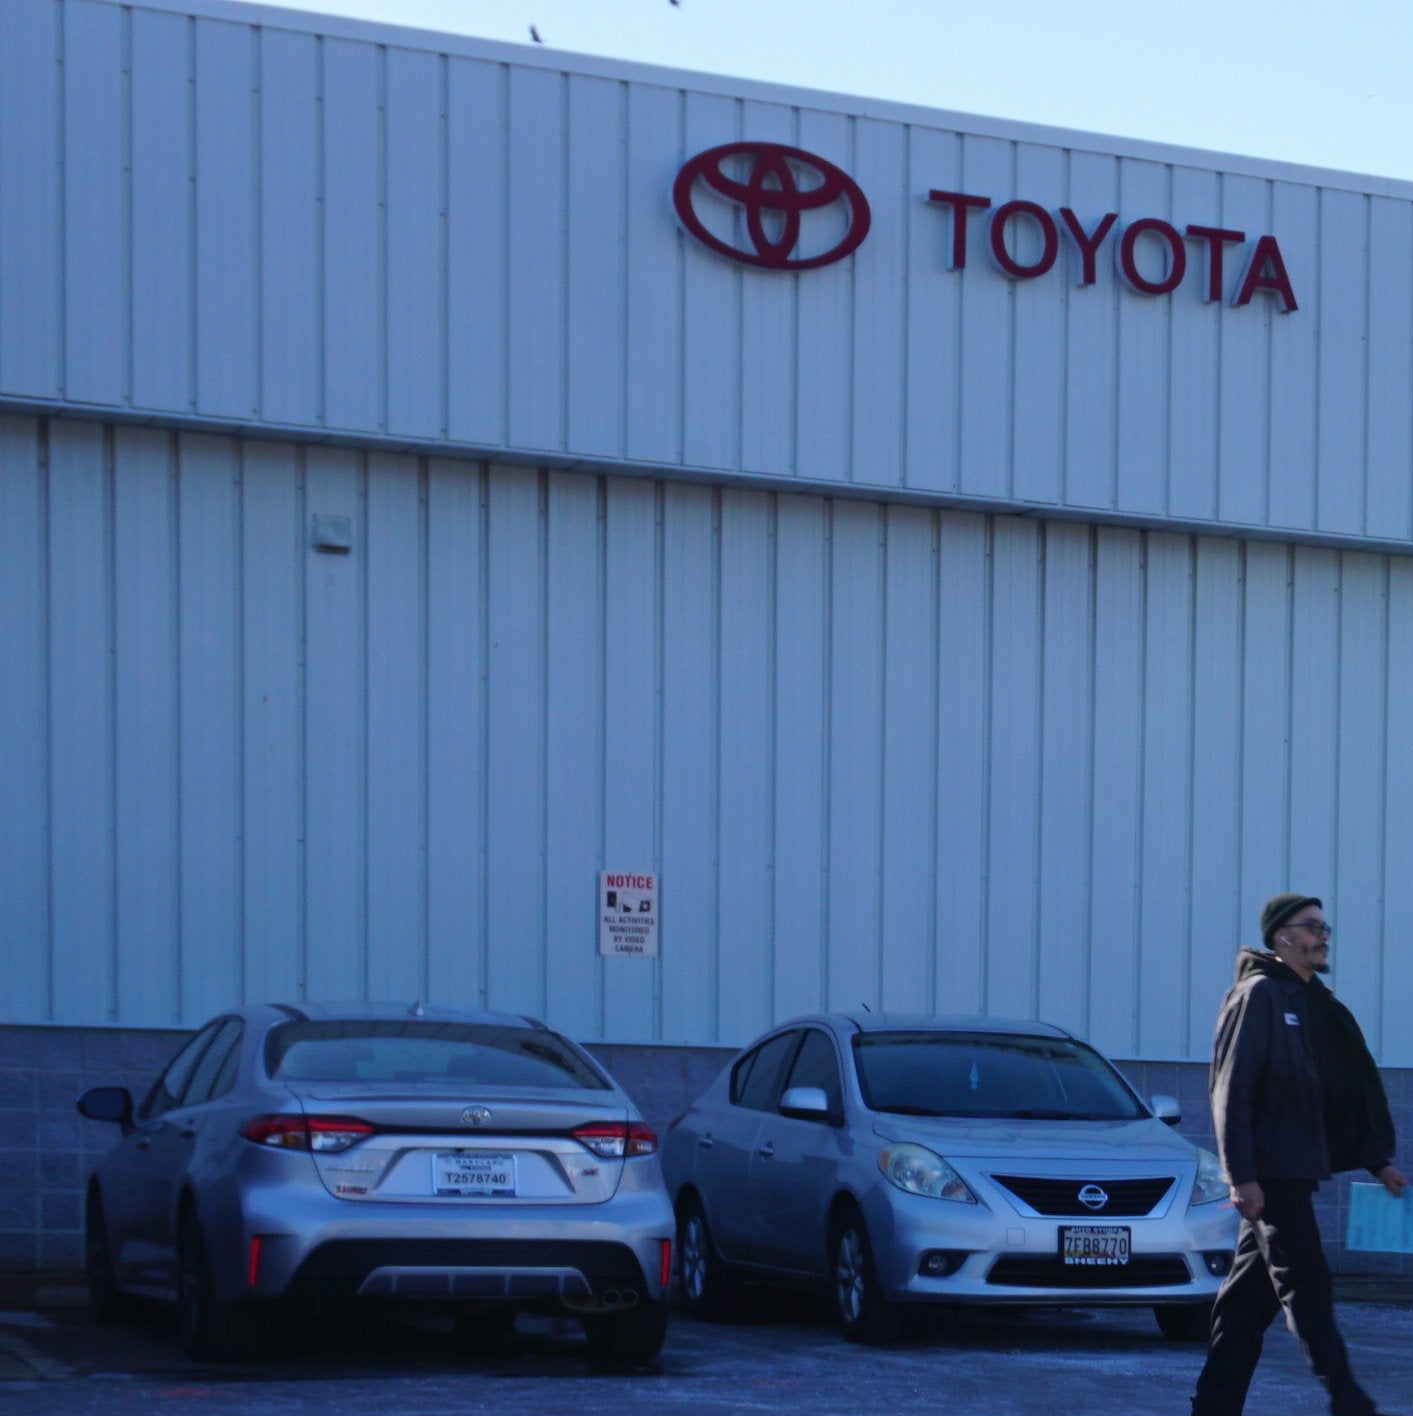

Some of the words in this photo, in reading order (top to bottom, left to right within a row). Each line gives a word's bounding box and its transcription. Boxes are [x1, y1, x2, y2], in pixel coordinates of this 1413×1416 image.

[929, 189, 1298, 314] TOYOTA
[607, 874, 653, 889] NOTICE
[446, 1172, 506, 1184] T2578740
